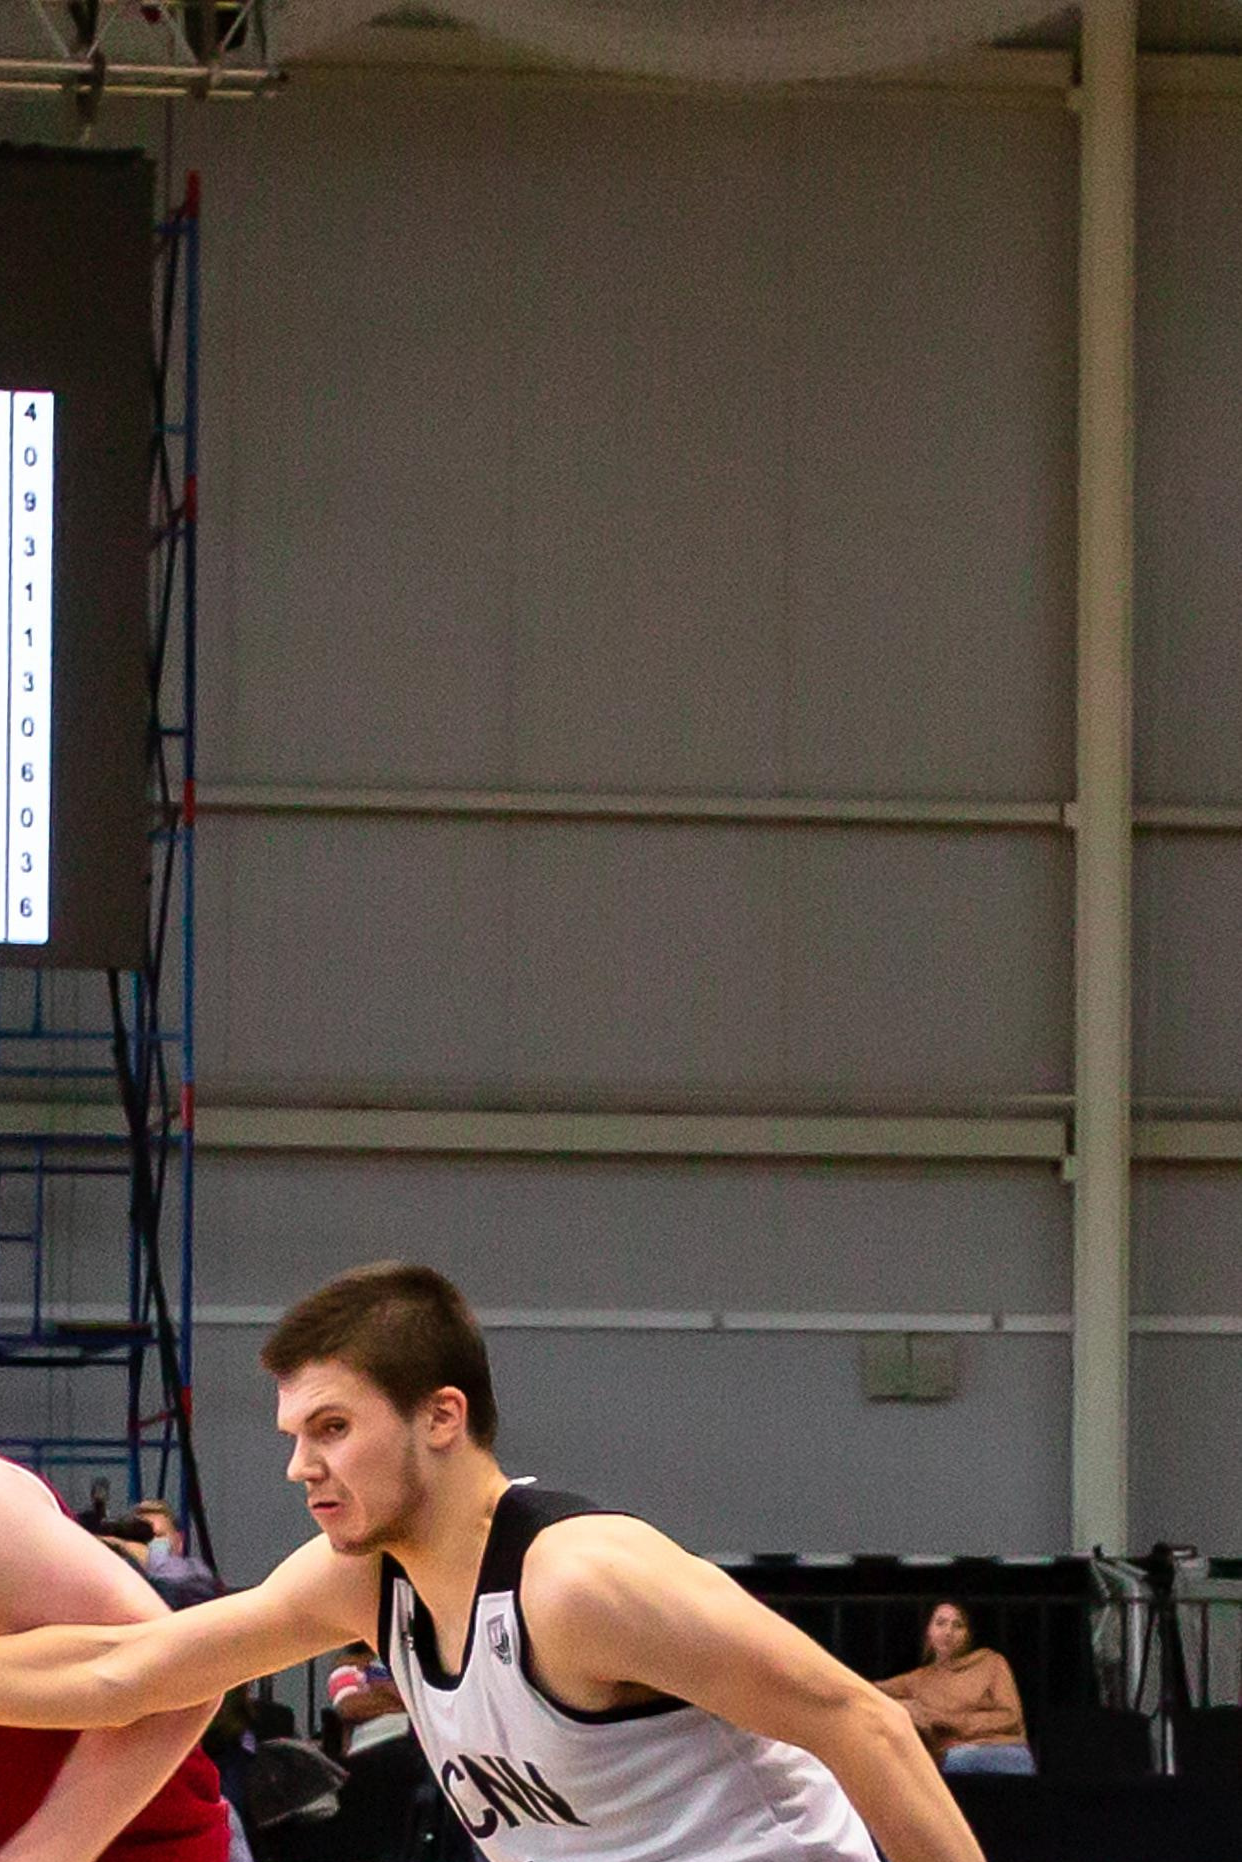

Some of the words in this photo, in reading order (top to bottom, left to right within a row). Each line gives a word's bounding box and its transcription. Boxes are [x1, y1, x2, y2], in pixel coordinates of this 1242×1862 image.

[23, 401, 37, 422] 4
[23, 446, 38, 468] 0
[23, 491, 37, 513] 9
[24, 536, 36, 558] 3
[24, 581, 33, 602] 1
[24, 627, 33, 648] 1
[23, 671, 35, 693] 3
[20, 717, 35, 738] 0
[20, 762, 35, 783] 6
[20, 807, 34, 829] 0
[21, 851, 33, 874] 3
[19, 897, 33, 919] 6
